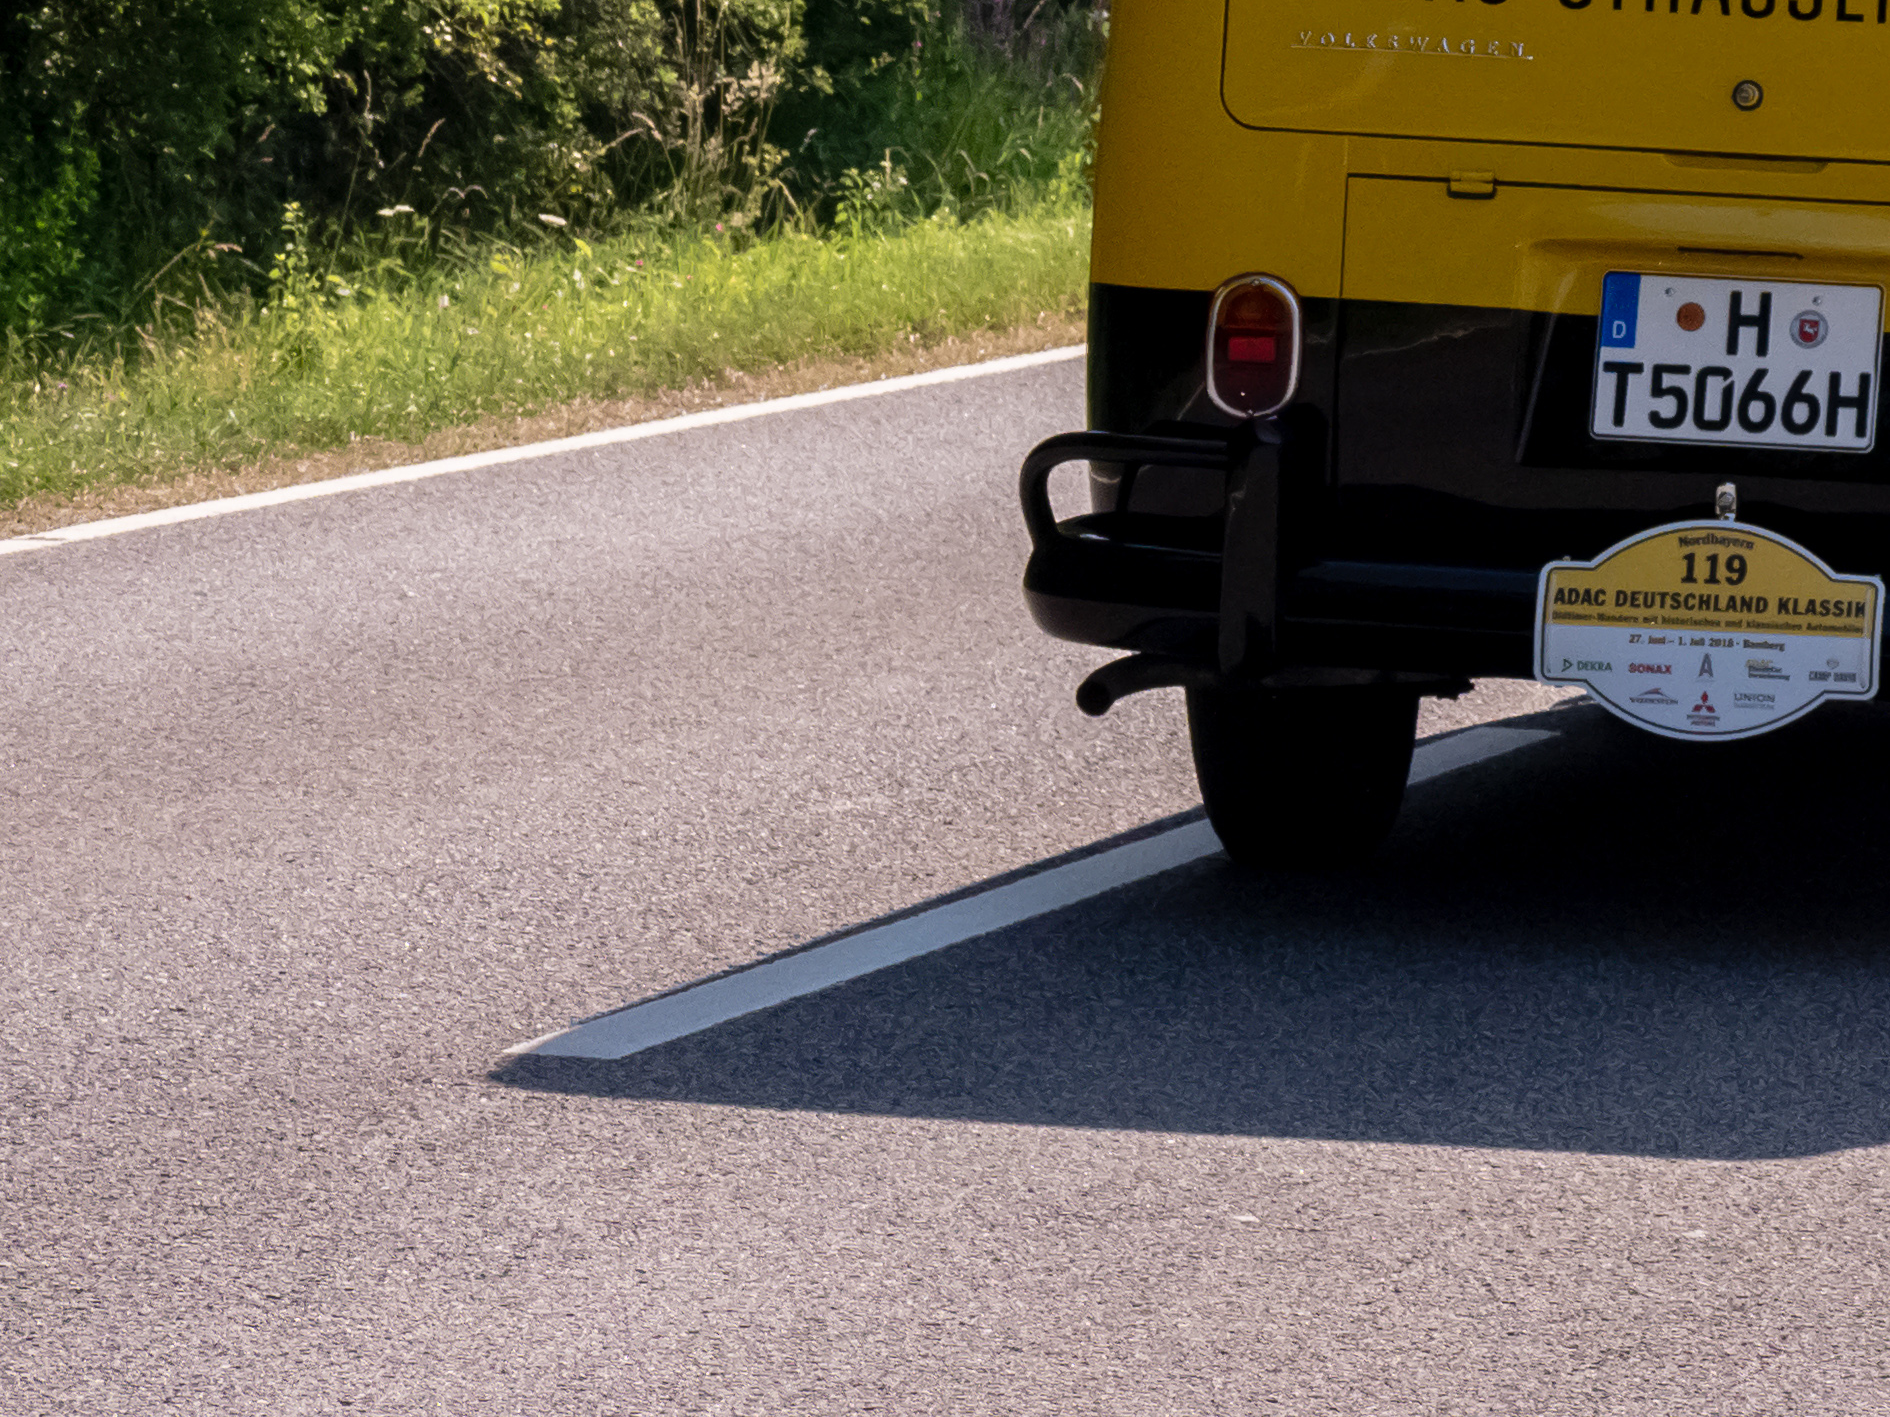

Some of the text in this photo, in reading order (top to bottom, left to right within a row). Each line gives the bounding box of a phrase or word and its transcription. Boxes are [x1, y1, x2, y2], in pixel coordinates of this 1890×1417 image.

[1299, 29, 1526, 58] VOLKSWAGEN
[1612, 320, 1627, 339] D
[1726, 290, 1772, 358] H
[1601, 361, 1872, 438] T5066H
[1678, 533, 1754, 550] Nordbayern
[1680, 552, 1748, 586] 119
[1553, 587, 1866, 619] ADAC DEUTSCHLAND KLASSIK
[1577, 660, 1613, 673] DEKRA
[1628, 662, 1672, 675] SONAX
